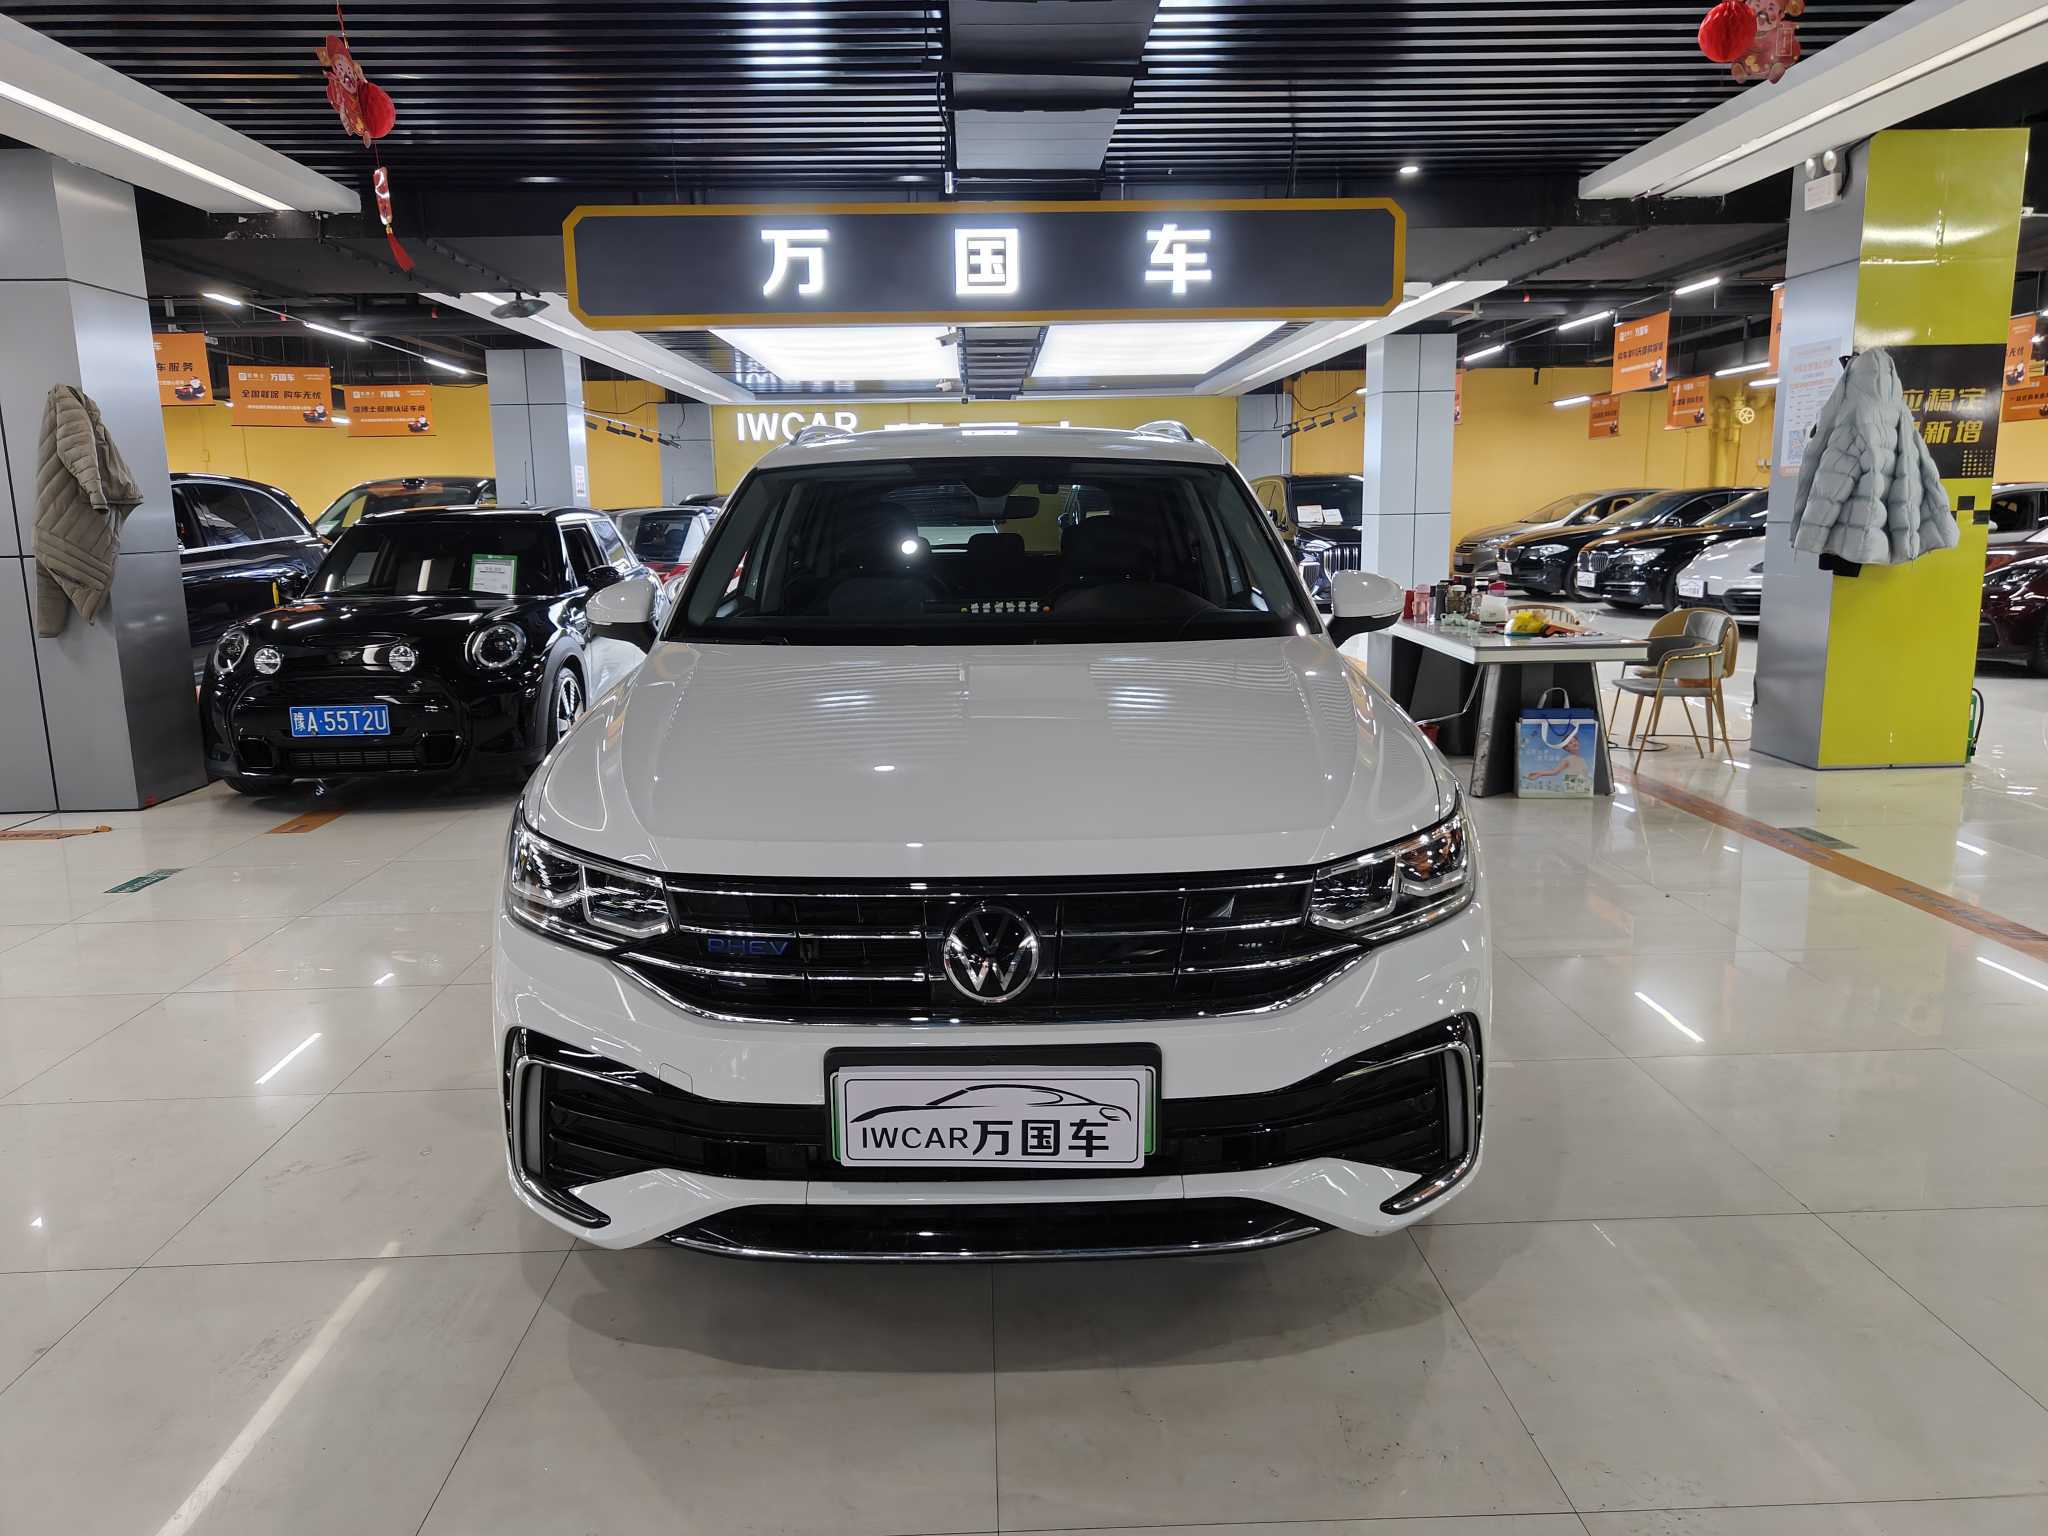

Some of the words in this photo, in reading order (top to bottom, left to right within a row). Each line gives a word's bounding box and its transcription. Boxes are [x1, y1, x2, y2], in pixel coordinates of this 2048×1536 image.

[761, 223, 1212, 296] 万国车
[1912, 419, 1983, 444] 新增
